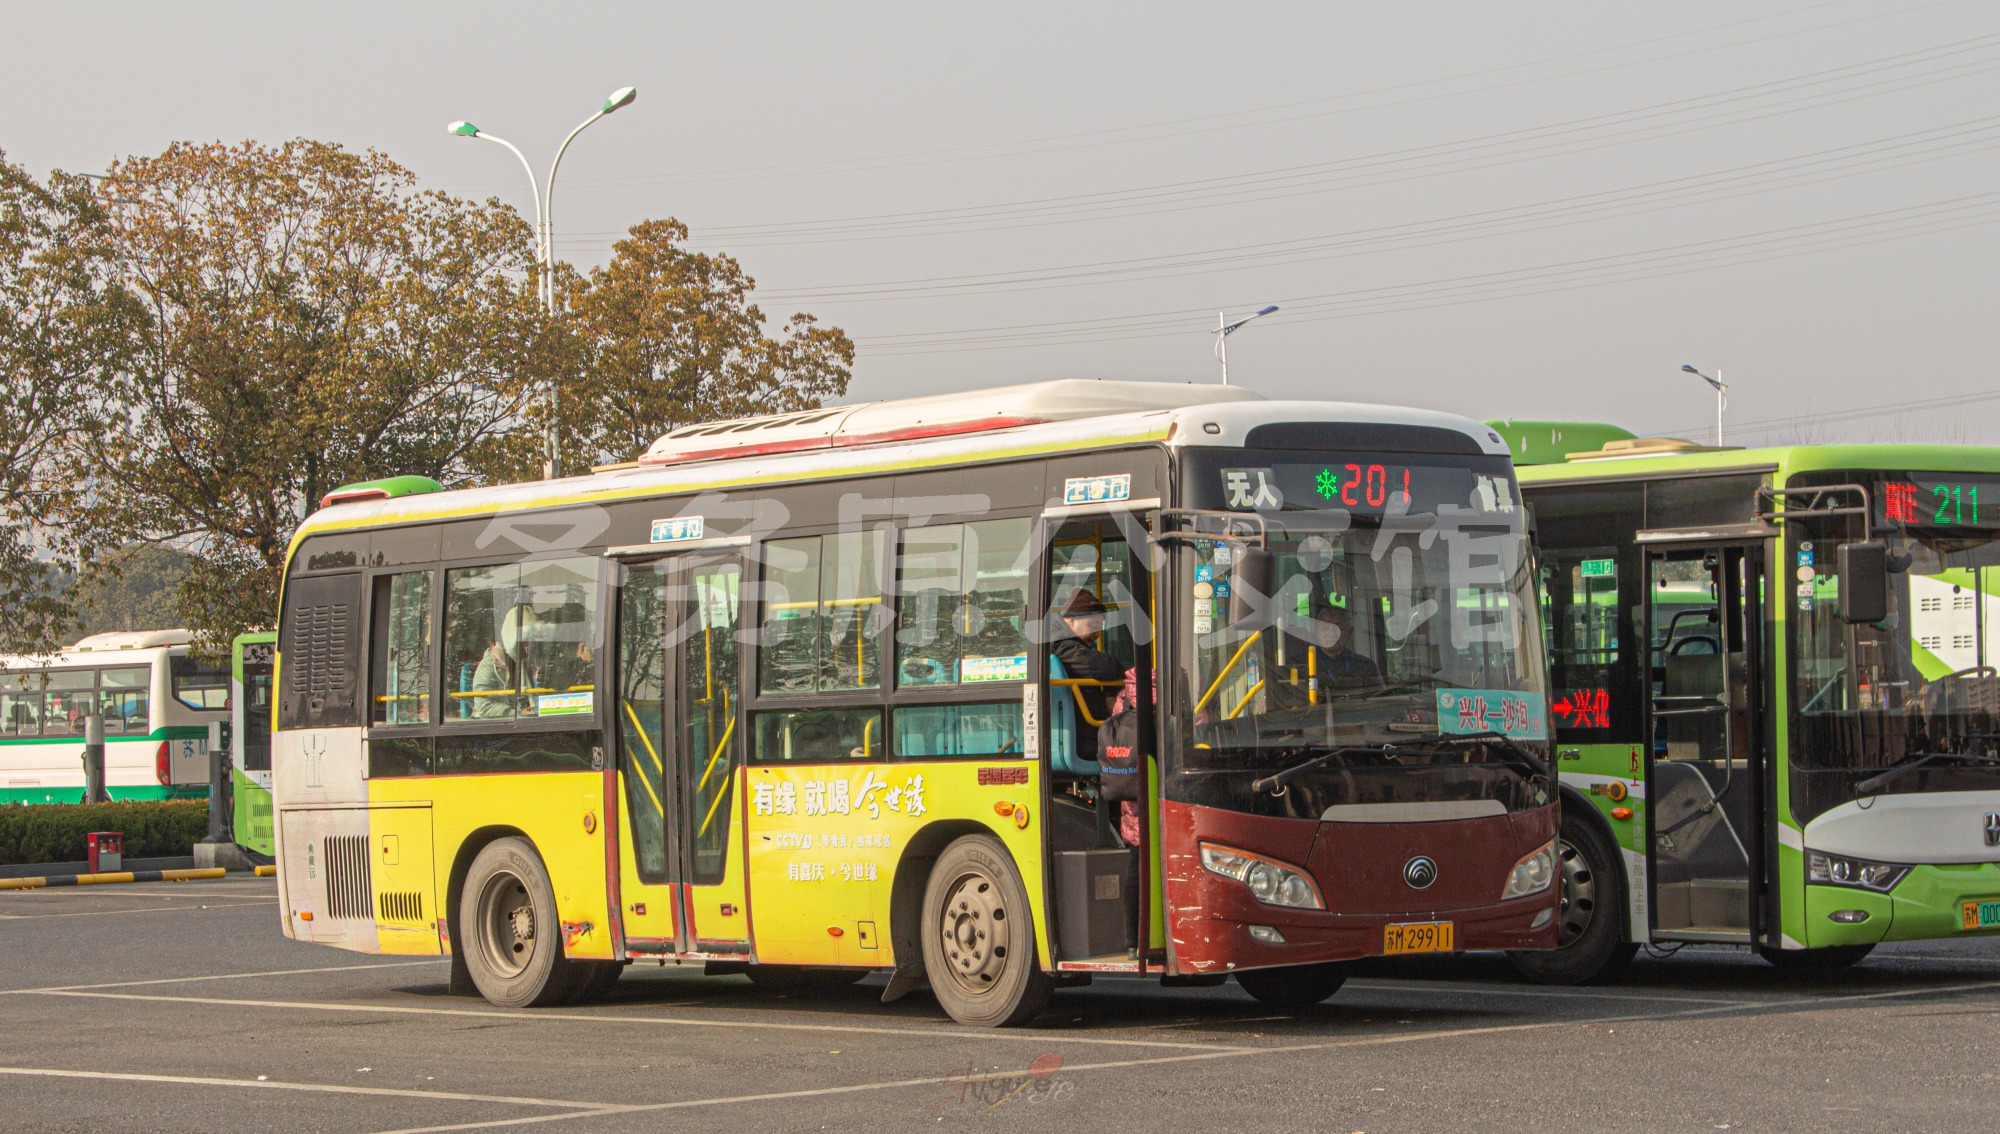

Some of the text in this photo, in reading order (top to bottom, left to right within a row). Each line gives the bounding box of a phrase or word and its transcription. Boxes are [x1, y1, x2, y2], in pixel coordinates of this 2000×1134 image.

[1226, 470, 1278, 508] 无人
[1341, 463, 1411, 507] 201
[1933, 484, 1979, 525] 211
[1573, 688, 1610, 728] 兴化
[752, 770, 927, 819] 有缘 就喝 今世缘
